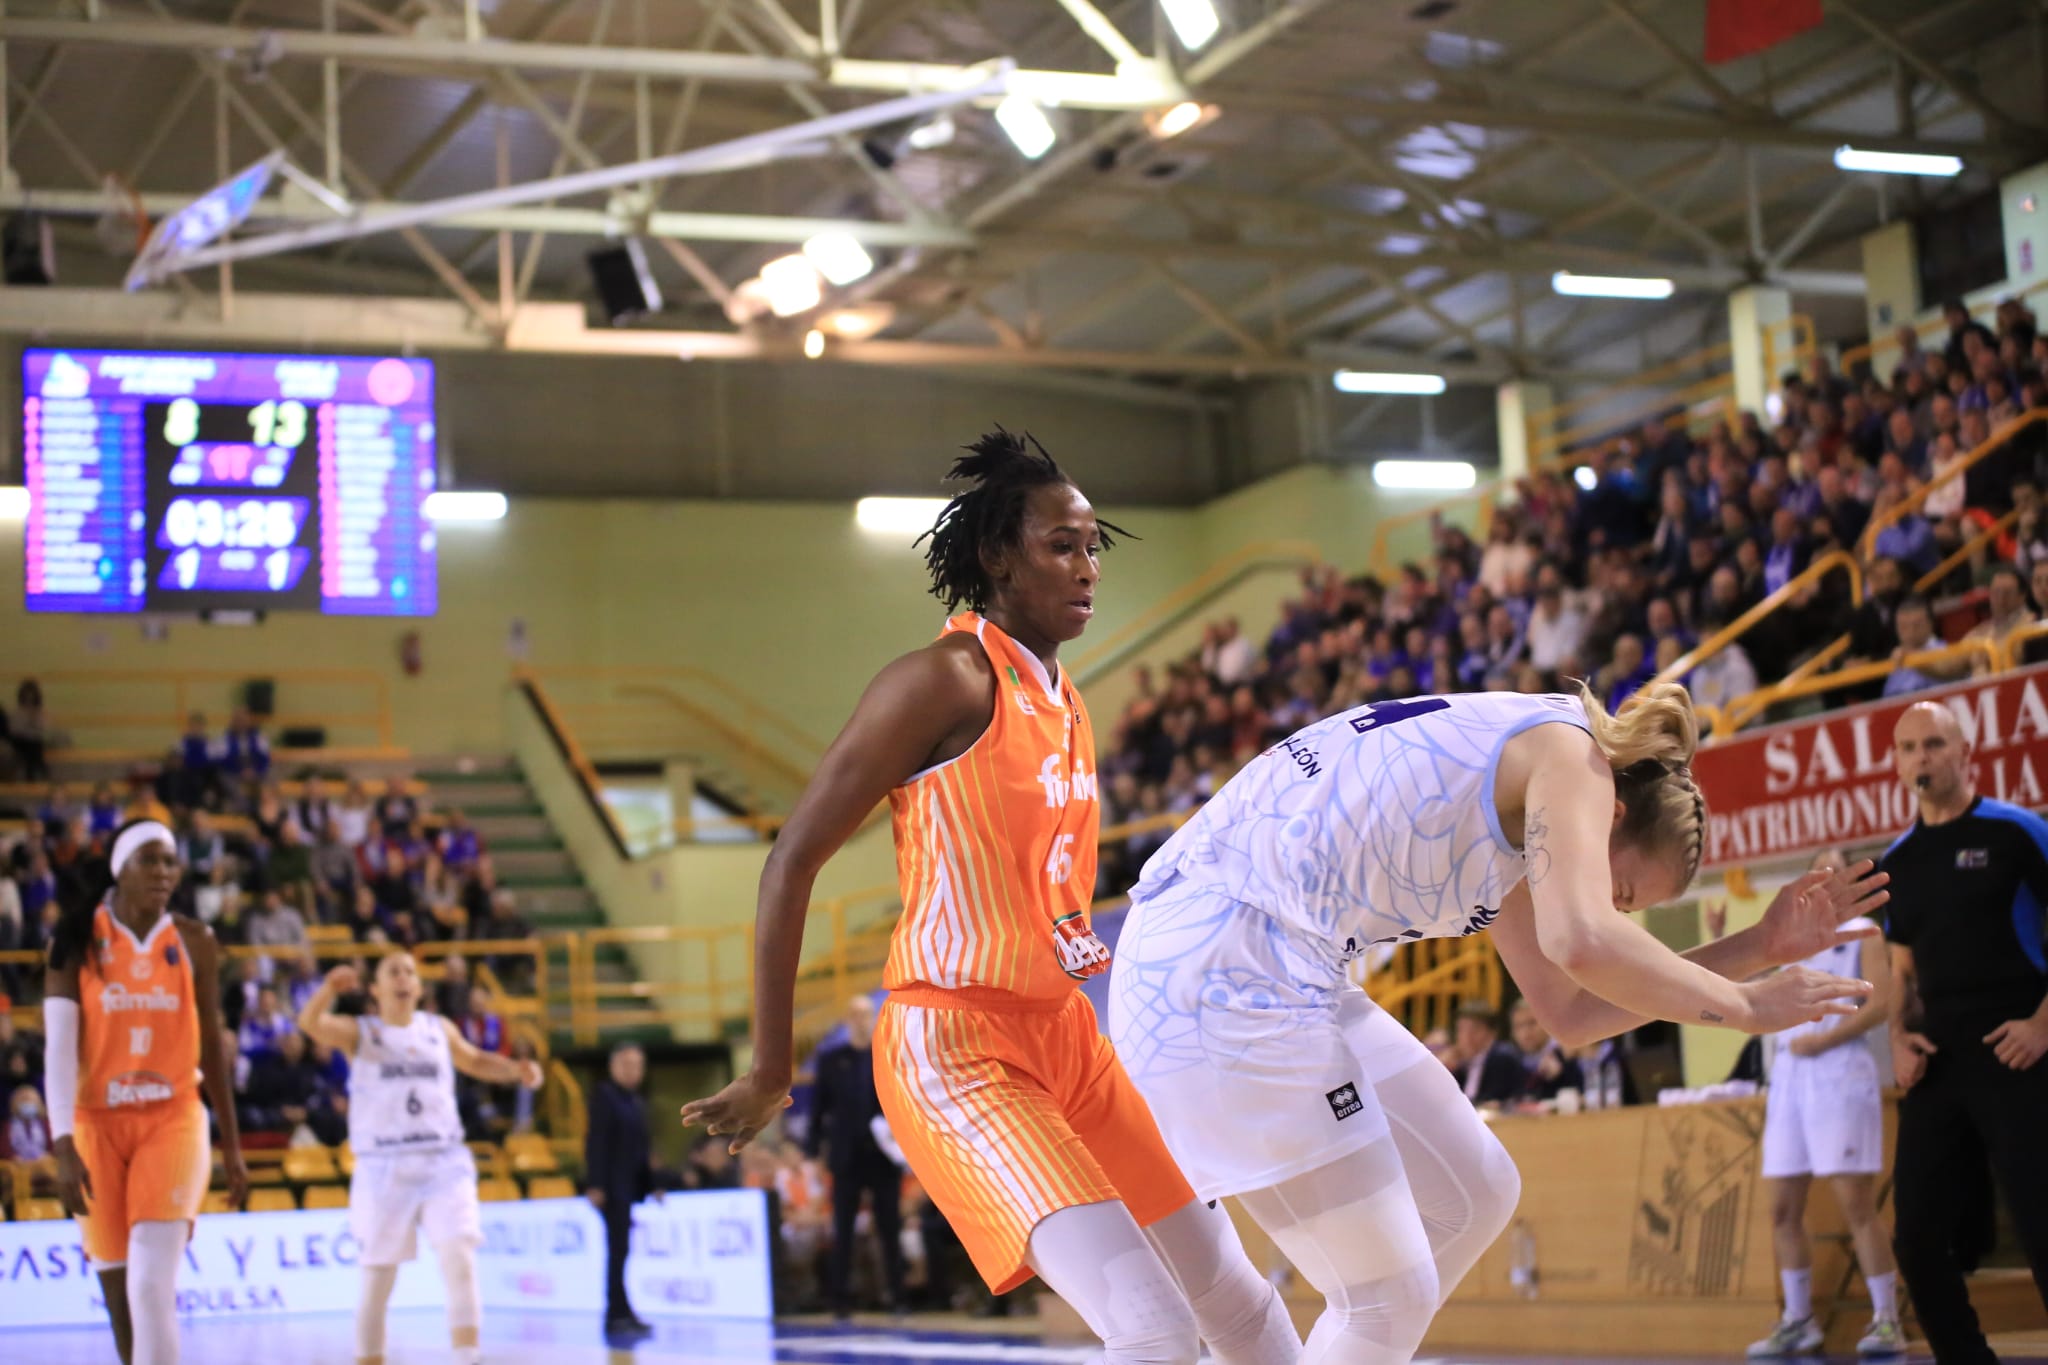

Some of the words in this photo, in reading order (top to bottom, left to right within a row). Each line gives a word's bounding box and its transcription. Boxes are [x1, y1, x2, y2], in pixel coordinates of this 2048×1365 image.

[248, 399, 307, 447] 13
[1765, 676, 2048, 793] SALMA
[1046, 833, 1075, 885] 45
[405, 1087, 424, 1117] 6
[226, 1237, 255, 1279] Y
